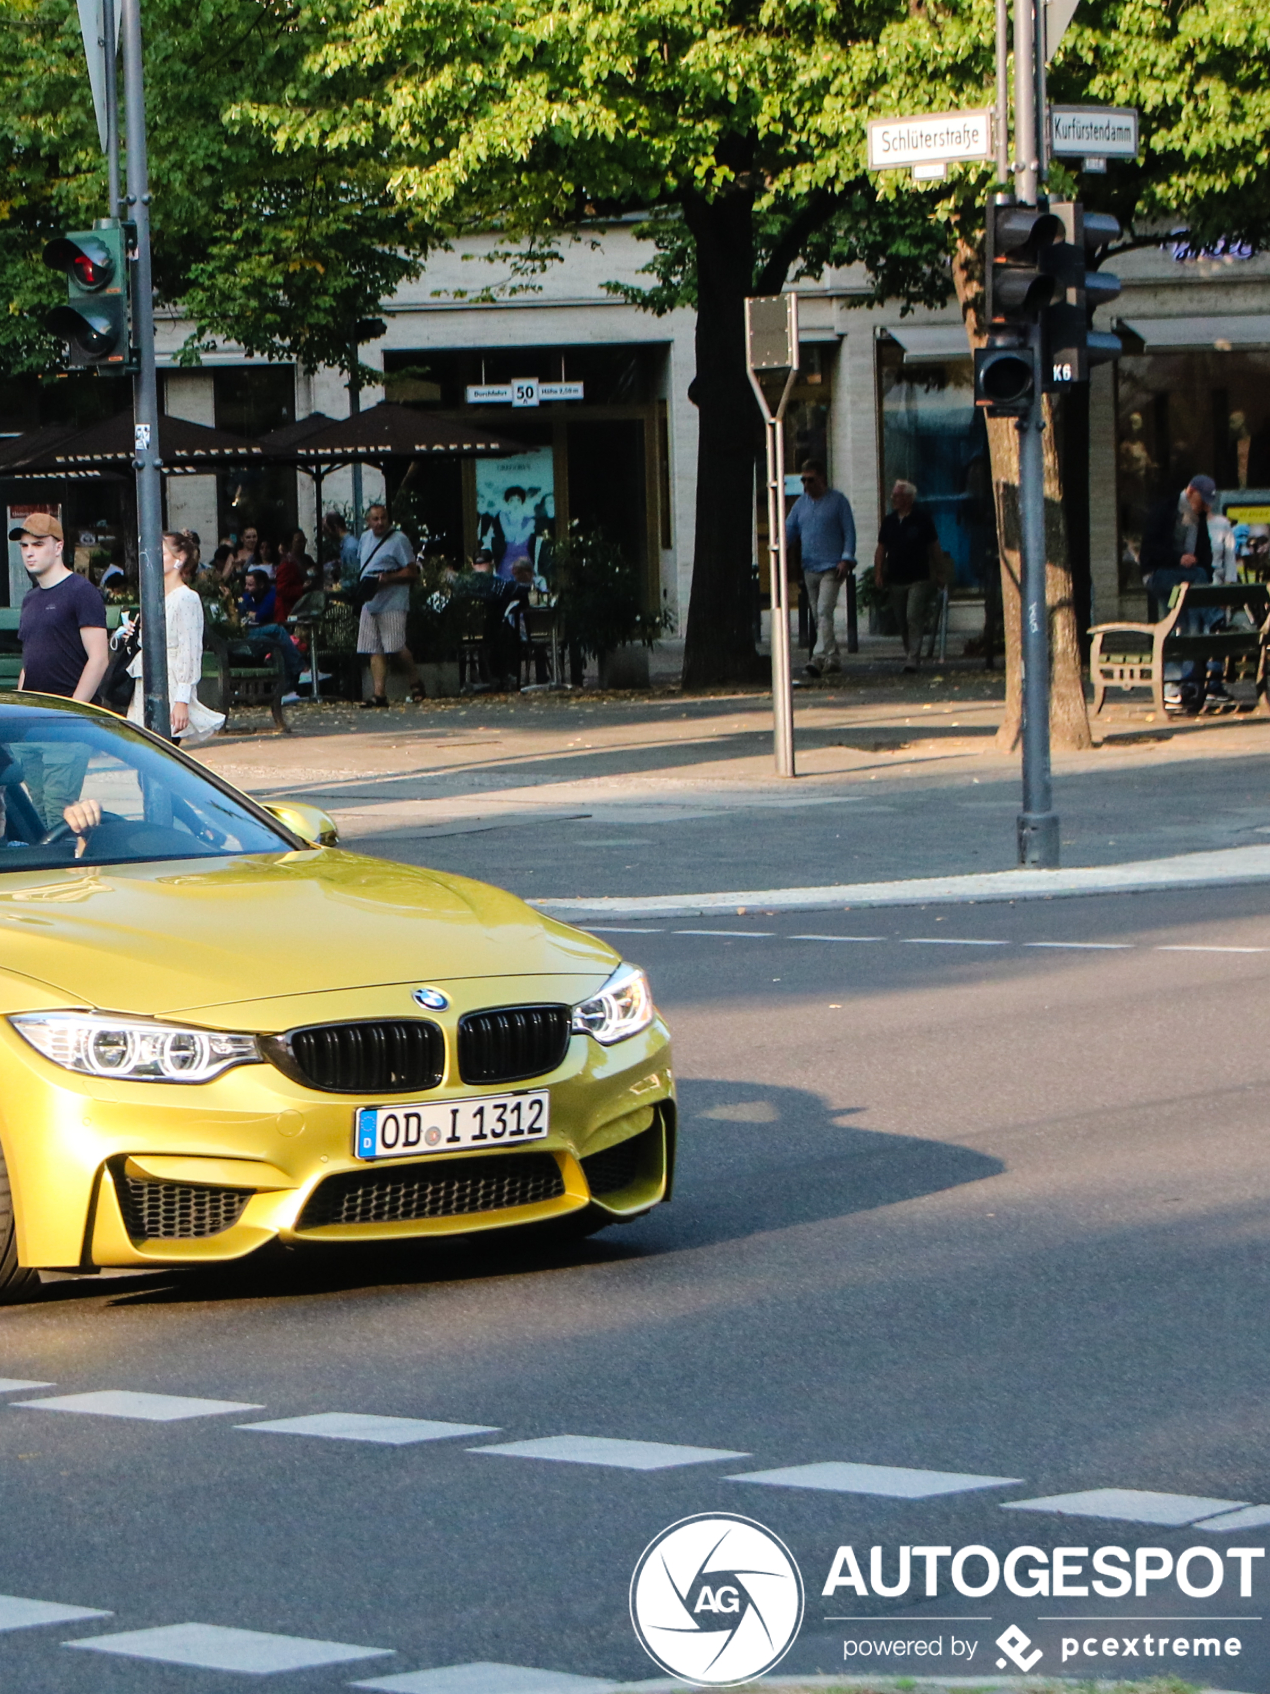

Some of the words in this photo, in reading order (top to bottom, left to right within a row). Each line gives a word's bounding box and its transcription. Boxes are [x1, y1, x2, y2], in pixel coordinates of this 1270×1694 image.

[881, 124, 979, 152] Schlüterstraße
[1054, 116, 1131, 143] Kurfürstendamm
[1053, 363, 1072, 381] K6
[517, 386, 534, 399] 50
[175, 447, 262, 456] KAFFEE
[381, 1112, 422, 1149] OD
[446, 1108, 461, 1143] I
[471, 1098, 543, 1141] 1312
[363, 1137, 372, 1148] D
